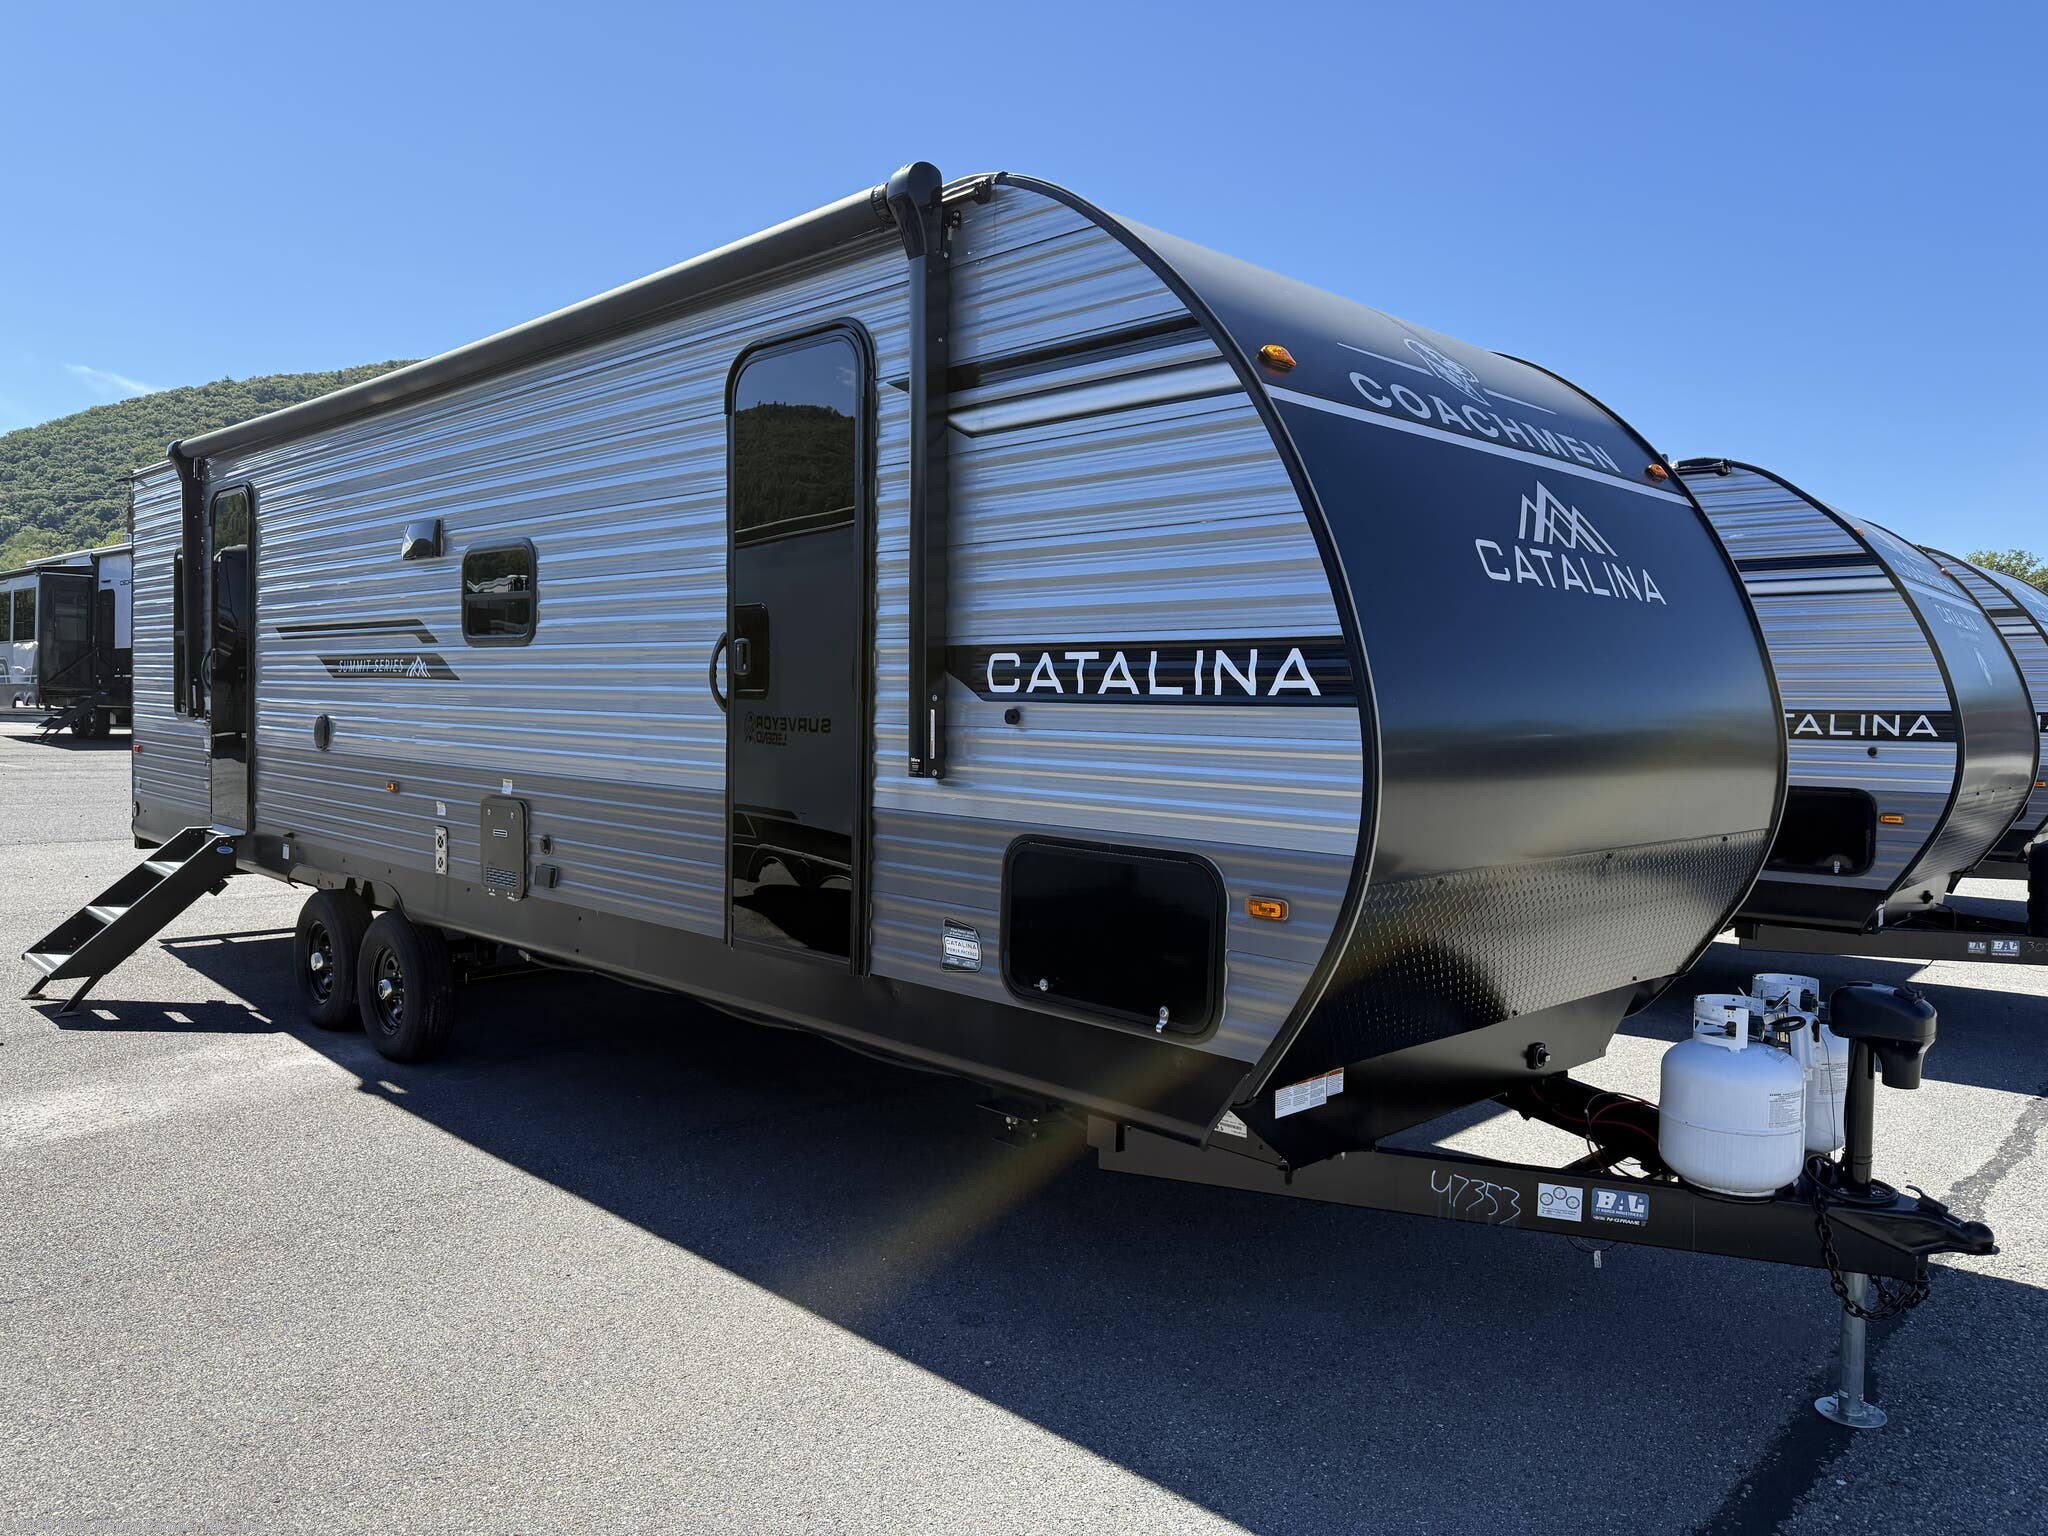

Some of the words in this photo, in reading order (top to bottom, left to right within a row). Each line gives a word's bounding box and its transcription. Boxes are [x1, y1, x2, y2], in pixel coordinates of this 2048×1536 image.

[1349, 371, 1621, 473] COACHMEN
[1475, 538, 1667, 605] CATALINA
[338, 660, 371, 673] SUMMIT
[373, 659, 404, 672] SERIES
[986, 647, 1321, 696] CATALINA
[1431, 1169, 1521, 1225] 47353
[1596, 1191, 1645, 1213] BAL
